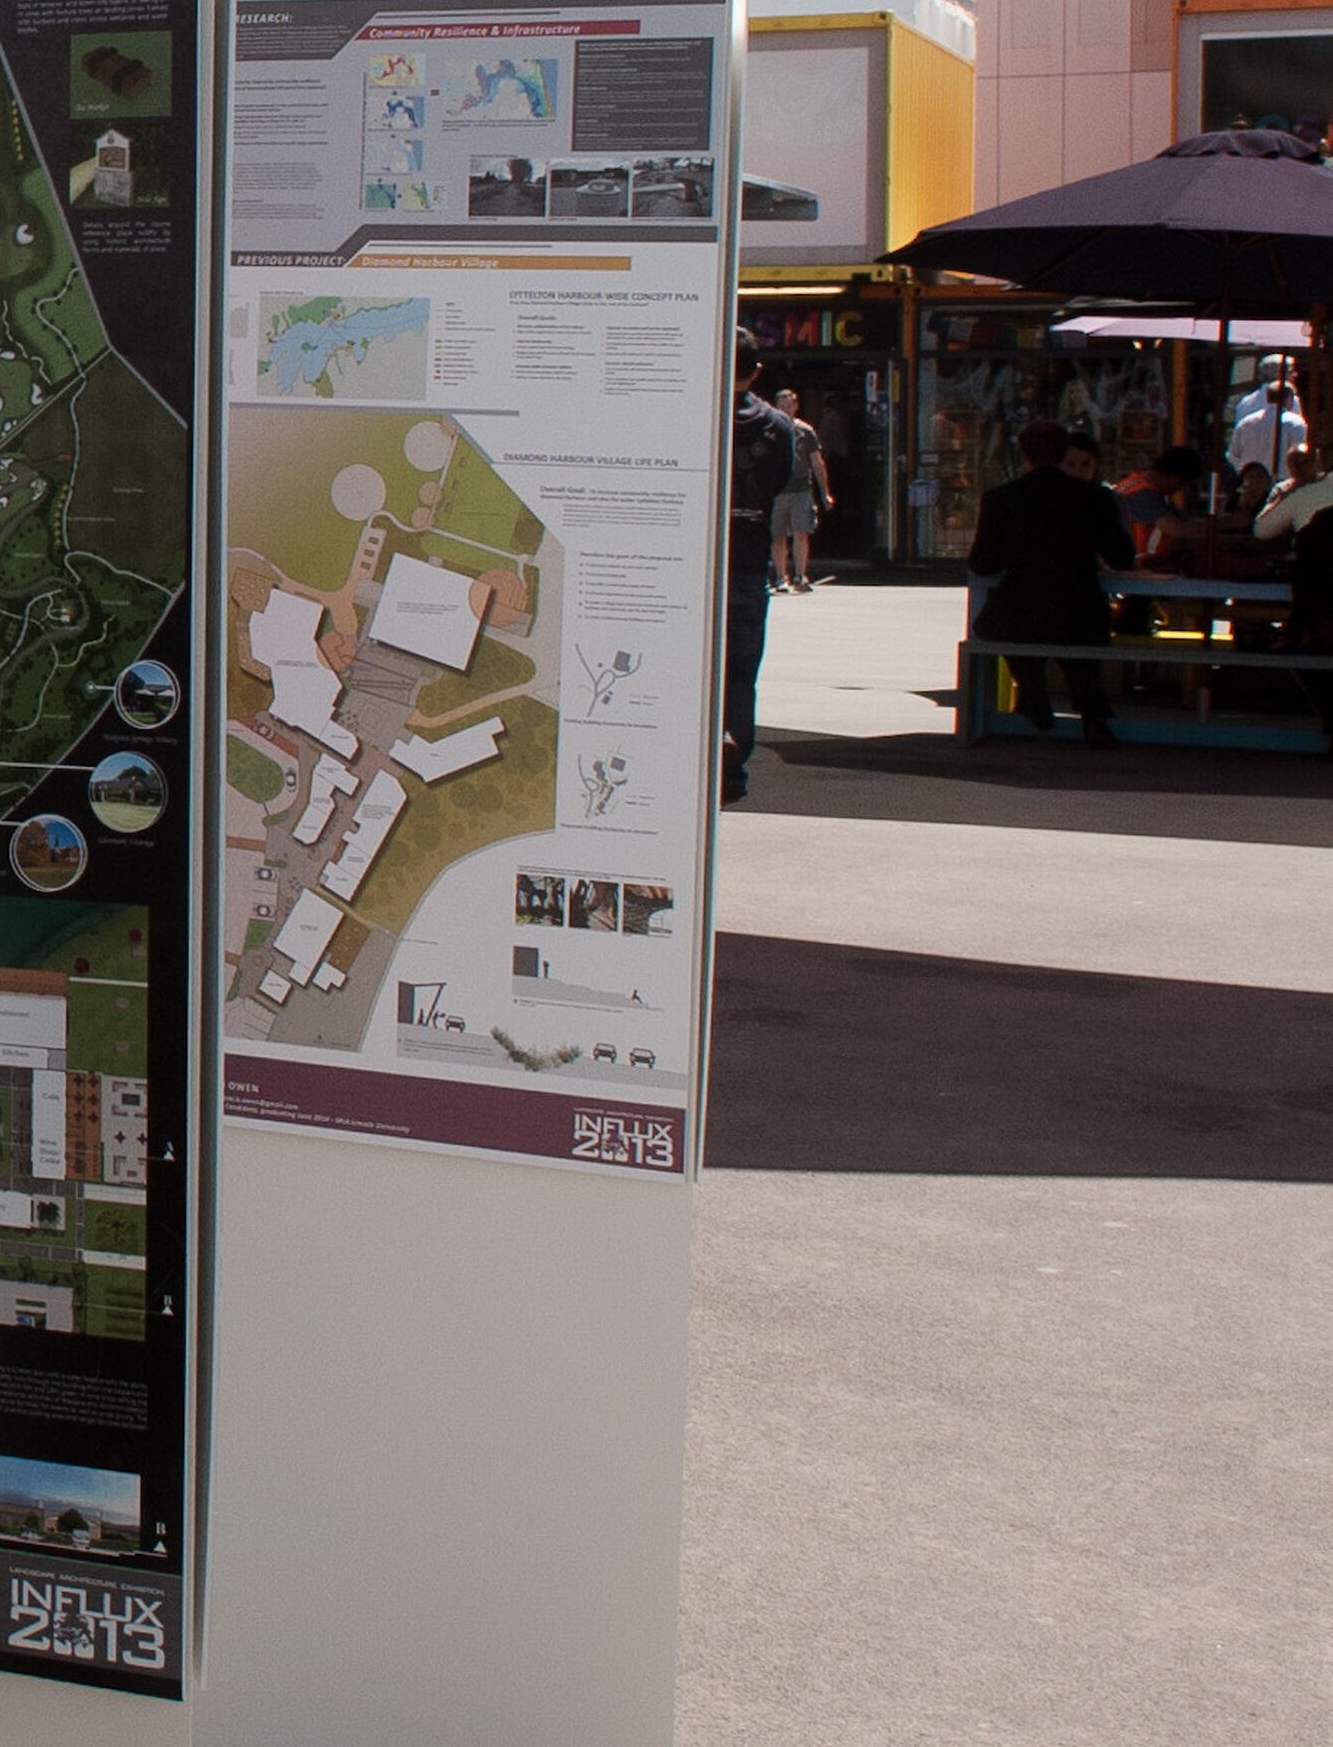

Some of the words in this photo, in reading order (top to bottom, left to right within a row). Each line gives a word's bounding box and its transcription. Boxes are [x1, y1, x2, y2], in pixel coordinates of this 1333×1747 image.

[369, 28, 431, 39] Community
[434, 27, 487, 37] Resilience
[491, 27, 499, 36] &
[503, 25, 581, 38] Infrastructure
[237, 255, 294, 265] PREVIOUS
[362, 257, 410, 267] Diamond
[413, 257, 458, 267] Harbour
[461, 258, 499, 269] Village
[509, 291, 556, 300] LYTTELTON
[632, 292, 673, 301] CONCEPT
[675, 293, 699, 301] PLAN
[739, 311, 863, 347] SMIC
[504, 453, 547, 462] DIAMOND
[550, 455, 594, 464] HARBOUR
[597, 456, 631, 465] VILLAGE
[635, 458, 651, 466] LIFE
[654, 458, 678, 467] PLAN
[573, 1114, 672, 1142] INFLUX
[572, 1130, 673, 1167] 2013
[11, 1578, 164, 1628] INFLUX
[8, 1605, 165, 1670] 2013
